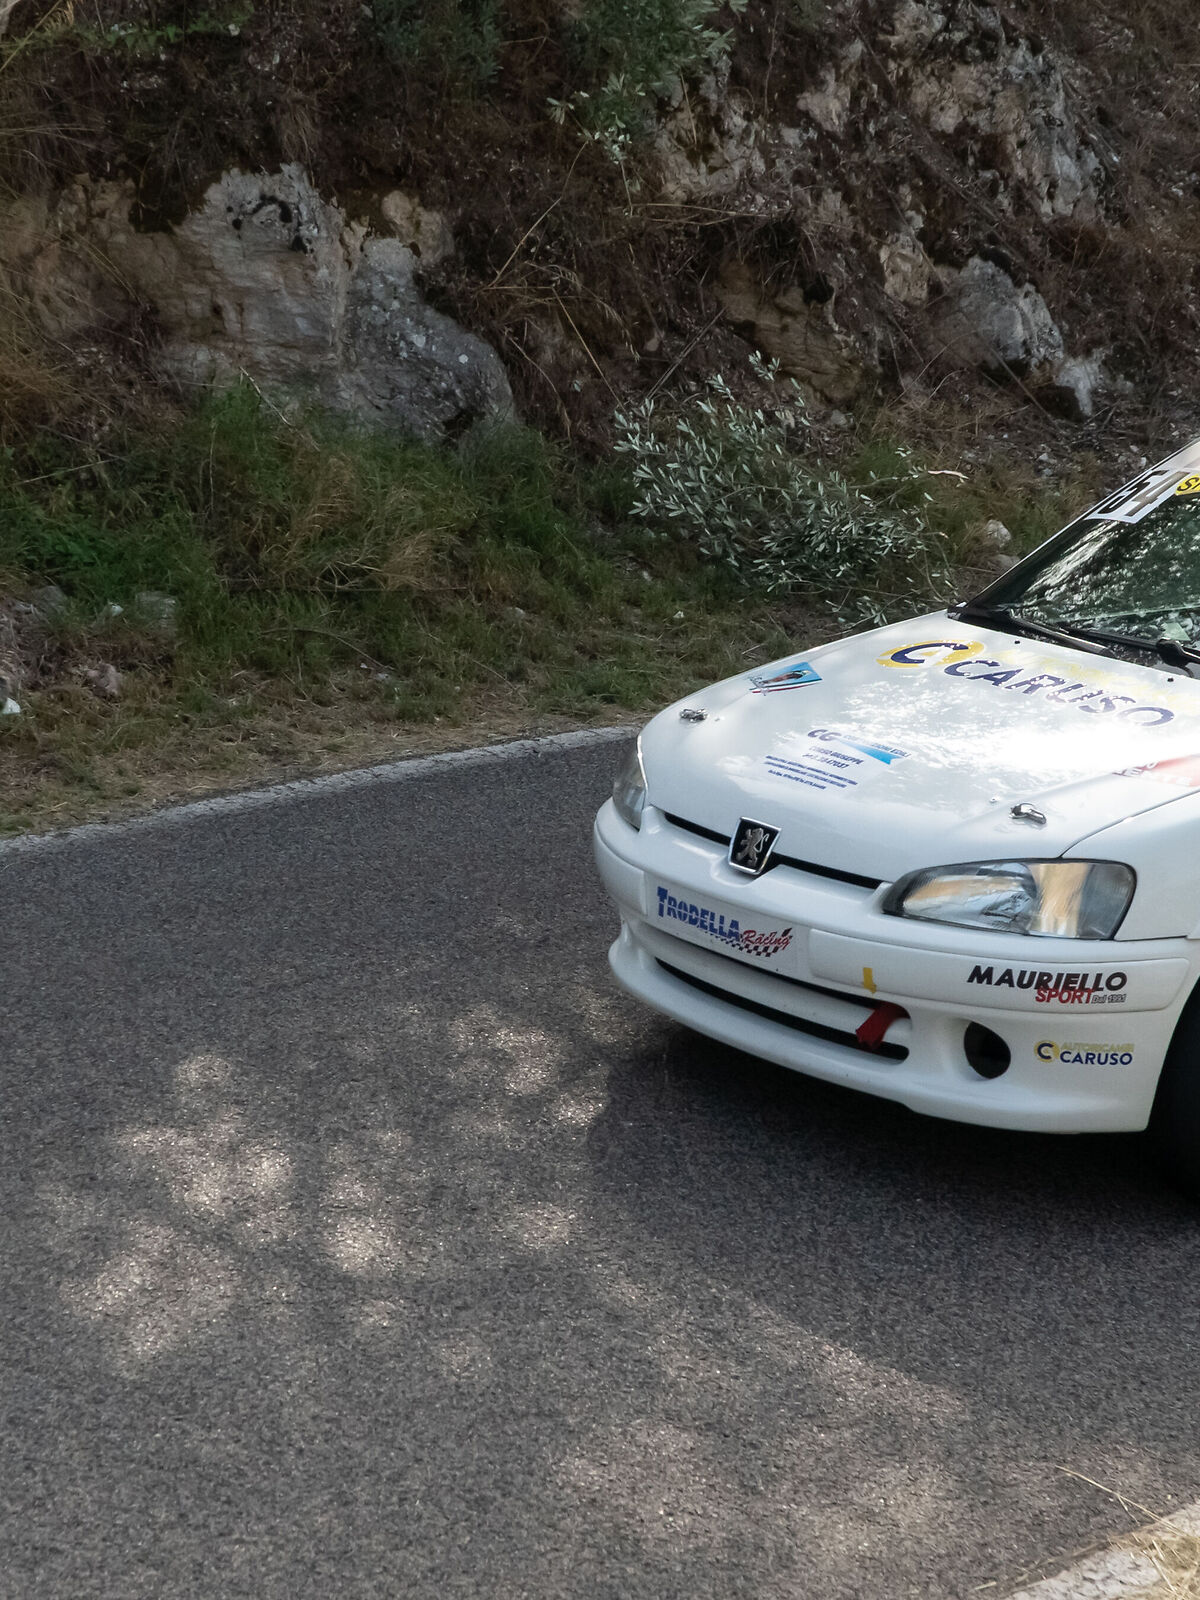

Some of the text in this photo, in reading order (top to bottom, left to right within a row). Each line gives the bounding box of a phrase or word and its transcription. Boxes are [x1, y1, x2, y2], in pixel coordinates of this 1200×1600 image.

[1097, 470, 1190, 517] 54
[943, 659, 1175, 727] CARUSO
[808, 729, 841, 741] CG
[656, 886, 790, 950] TRODELLA Racing
[967, 965, 1127, 991] MAURIELLO
[1035, 986, 1094, 1004] SPORT
[1060, 1051, 1132, 1065] CARUSO
